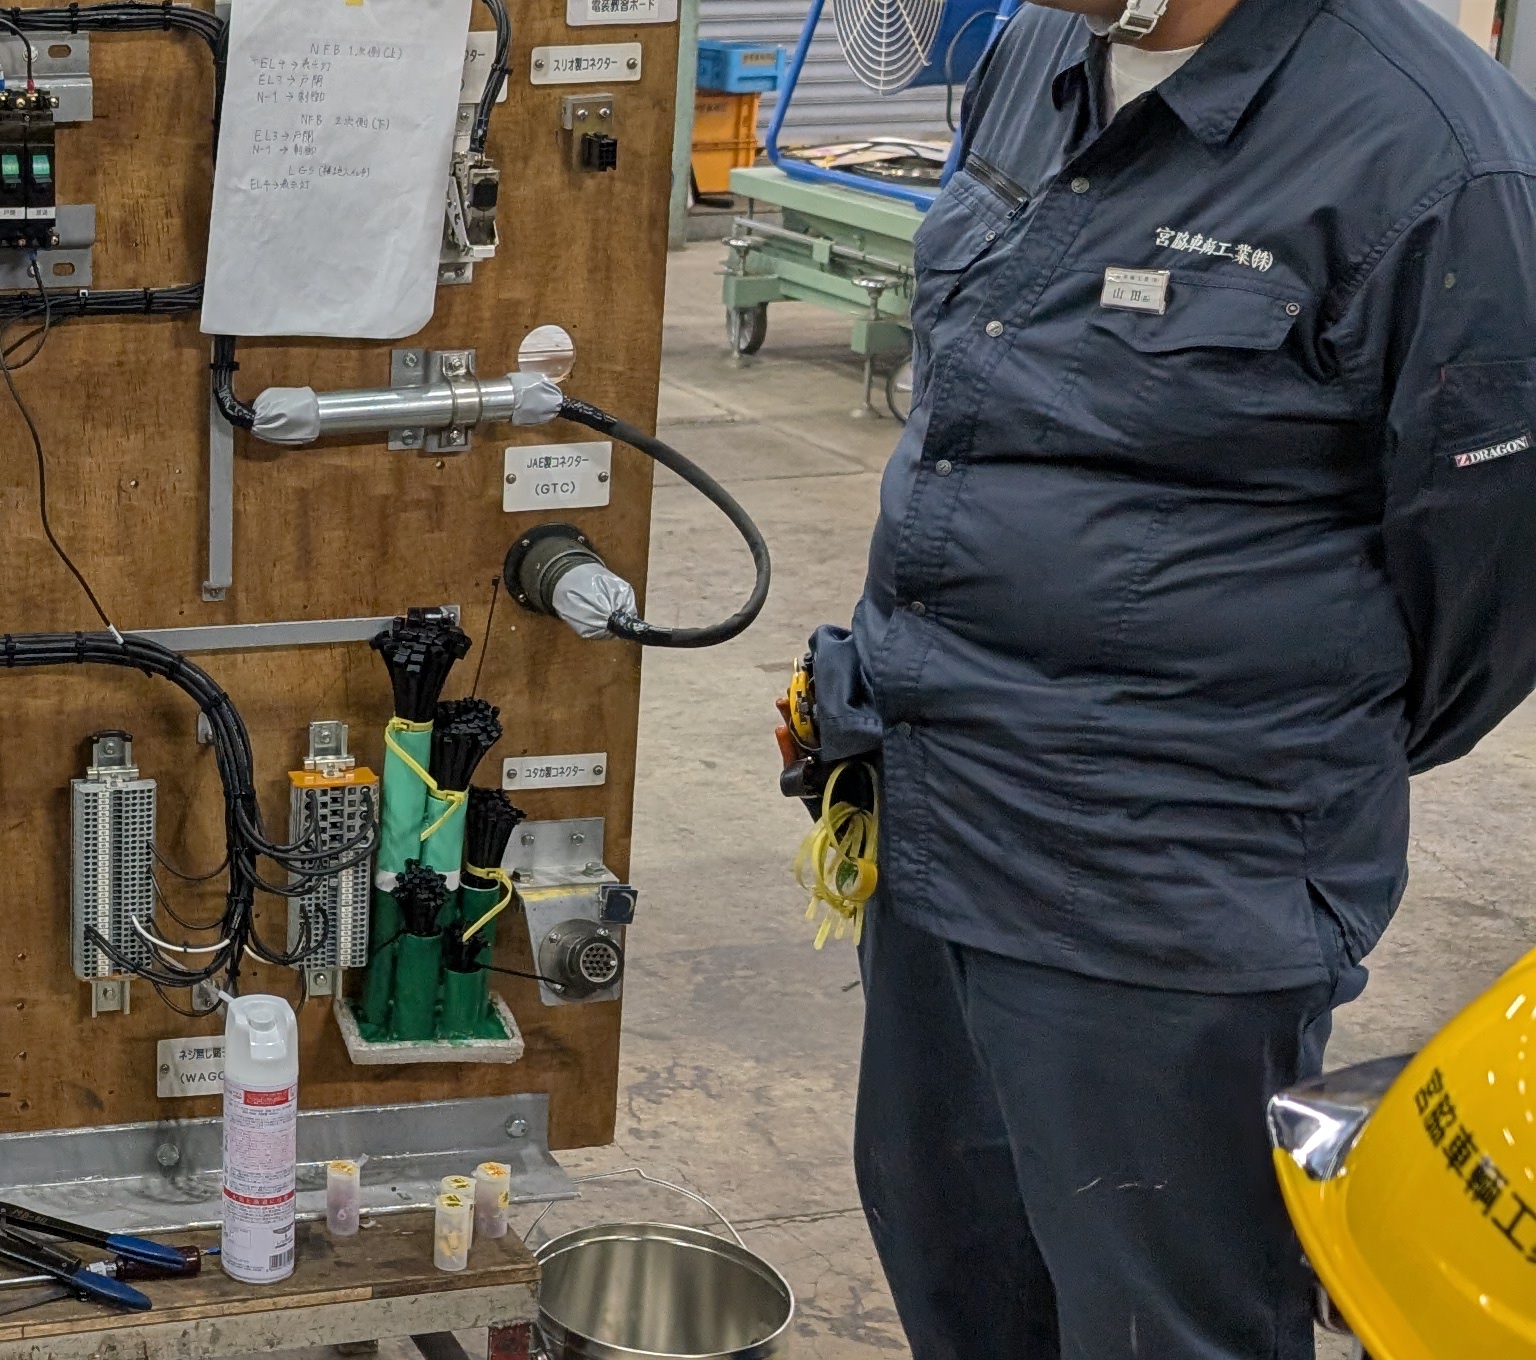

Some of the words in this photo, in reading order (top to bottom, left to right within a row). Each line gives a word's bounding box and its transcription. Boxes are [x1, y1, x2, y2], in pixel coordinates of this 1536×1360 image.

[553, 56, 618, 72] スリオ製コネクター
[526, 455, 590, 469] JAE製コネクター
[535, 481, 576, 496] (GTC)
